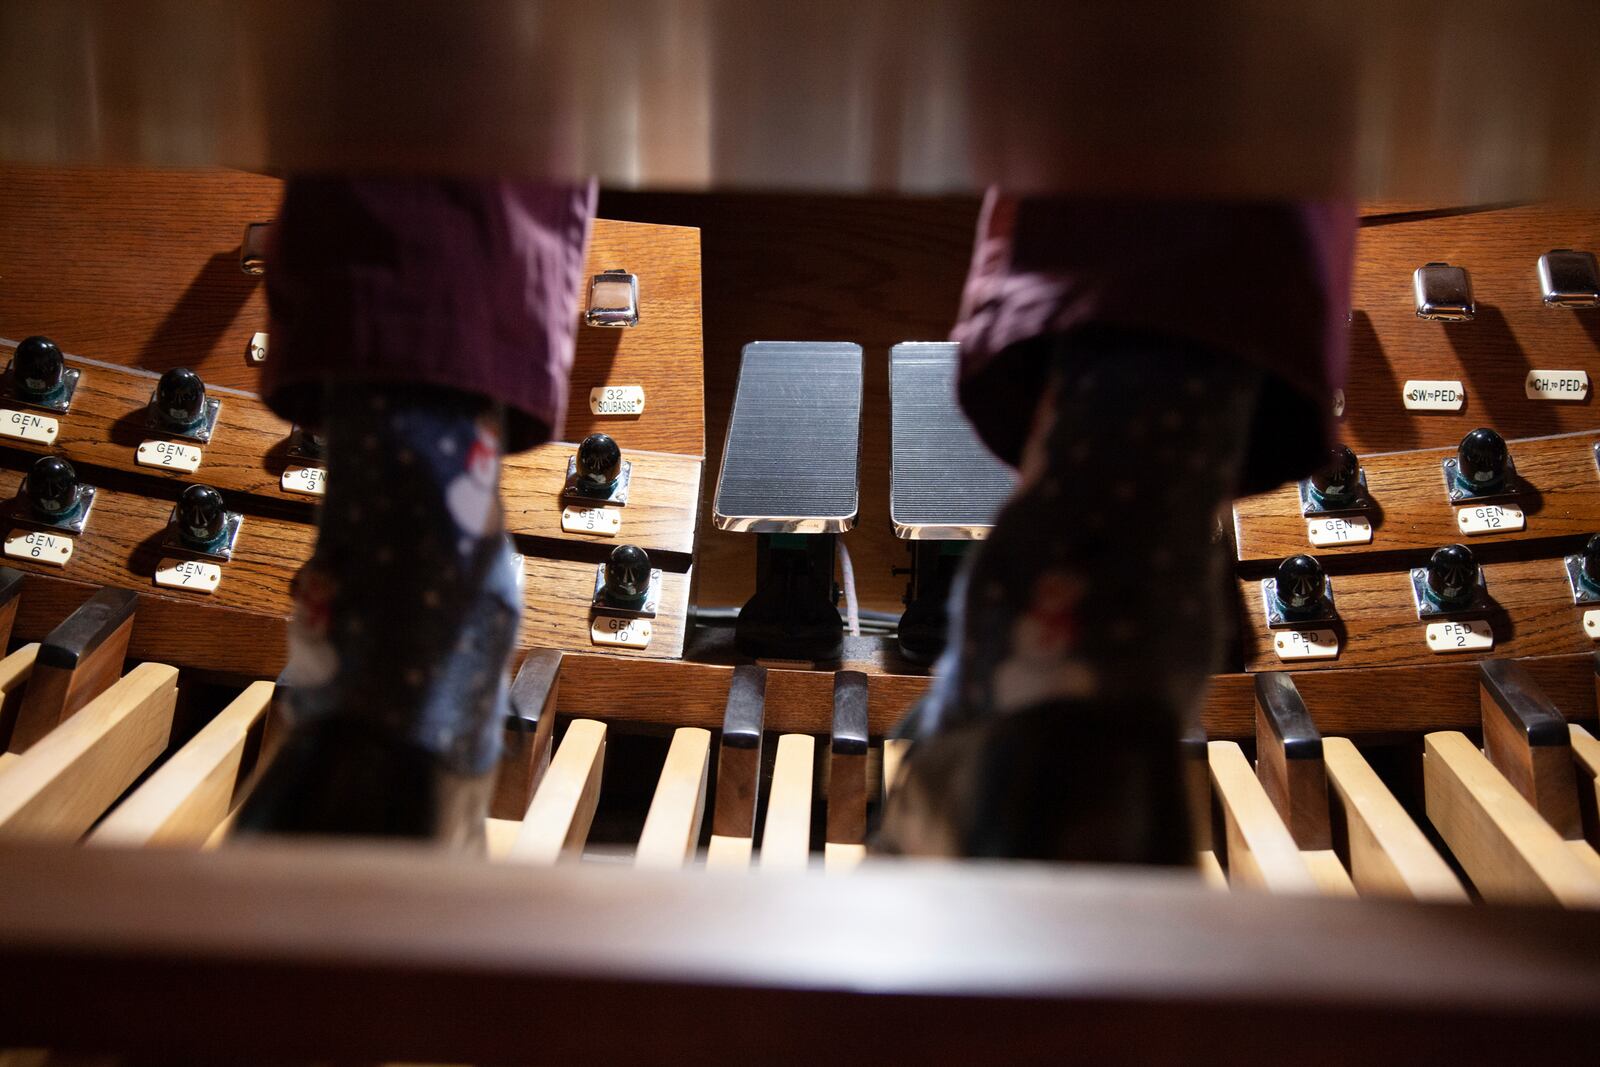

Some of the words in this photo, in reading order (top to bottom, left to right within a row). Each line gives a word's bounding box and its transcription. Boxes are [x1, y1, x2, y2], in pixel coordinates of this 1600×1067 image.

[1534, 379, 1551, 392] CH.
[1559, 379, 1581, 392] PED.
[1412, 390, 1428, 402] SW.
[1434, 390, 1458, 402] PED.
[598, 401, 636, 413] SOUBASSE
[11, 413, 43, 429] GEN.
[20, 426, 26, 436] 1
[156, 443, 187, 457] GEN.
[163, 455, 172, 465] 2
[306, 481, 315, 491] 3
[1325, 519, 1358, 531] GEN.
[1484, 518, 1501, 529] 12
[25, 533, 57, 549] GEN.
[1335, 530, 1348, 541] 11
[31, 547, 40, 557] 6
[175, 562, 207, 577] GEN.
[182, 574, 191, 585] 7
[614, 632, 628, 642] 10
[1292, 632, 1324, 644] PED.
[1456, 636, 1467, 647] 2
[1304, 645, 1310, 655] 1
